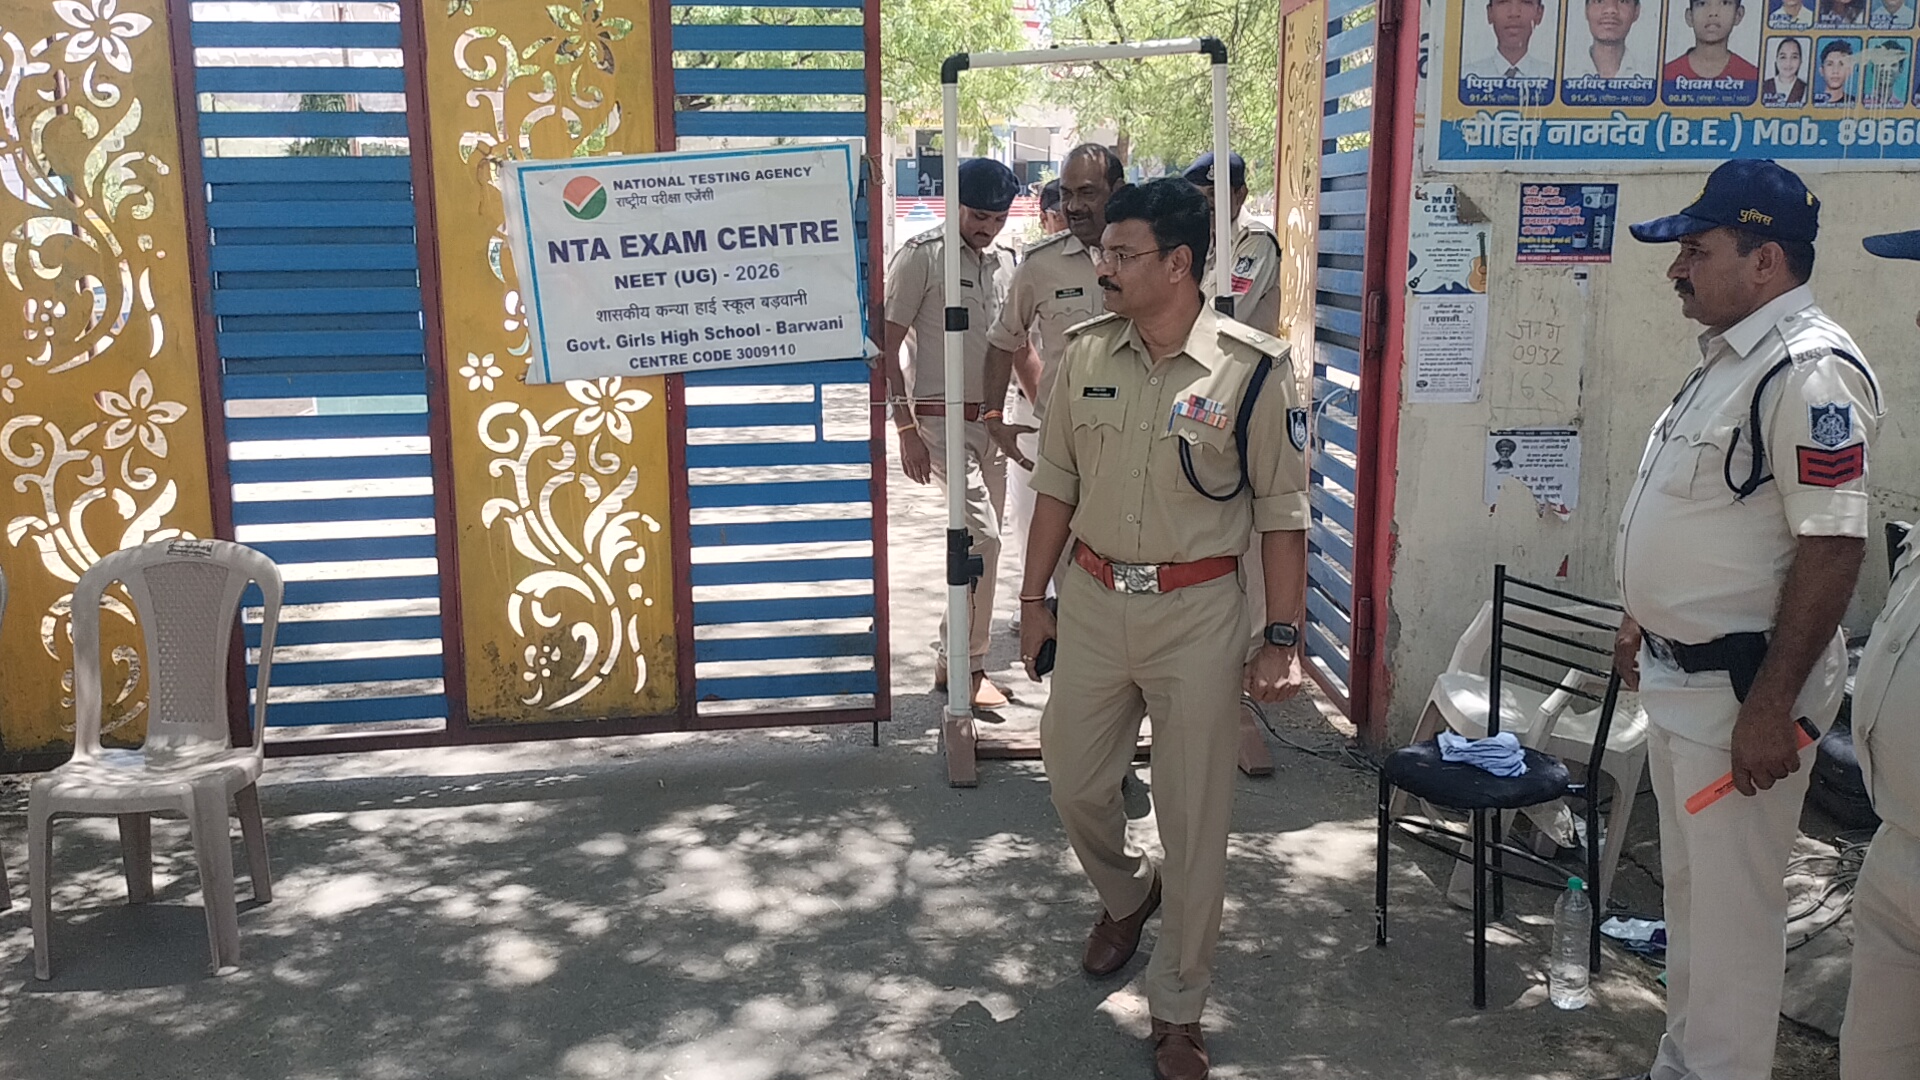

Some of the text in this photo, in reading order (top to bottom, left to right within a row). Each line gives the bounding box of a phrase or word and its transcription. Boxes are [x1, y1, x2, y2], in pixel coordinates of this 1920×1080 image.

[1676, 75, 1744, 90] शिवम पटेल
[1546, 111, 1649, 146] नामदेव
[1656, 113, 1742, 152] (B.E.)
[1753, 117, 1828, 145] Mob.
[613, 166, 812, 191] NATIONAL TESTING AGENCY
[616, 187, 714, 209] राष्ट्रीय परीक्षा एजेंसी
[1739, 208, 1773, 226] पुलिस
[548, 220, 839, 264] NTA EXAM CENTRE
[615, 271, 667, 290] NEET
[675, 266, 717, 287] (UG)
[735, 263, 780, 282] 2026
[596, 289, 808, 323] शासकीय कन्या हाई स्कूल बड़वानी
[566, 334, 610, 354] Govt.
[616, 330, 655, 349] Girls
[661, 325, 699, 346] High
[704, 323, 761, 341] School
[776, 315, 843, 336] Barwani
[629, 343, 796, 370] CENTRE CODE 3009110
[1513, 345, 1564, 365] 0932
